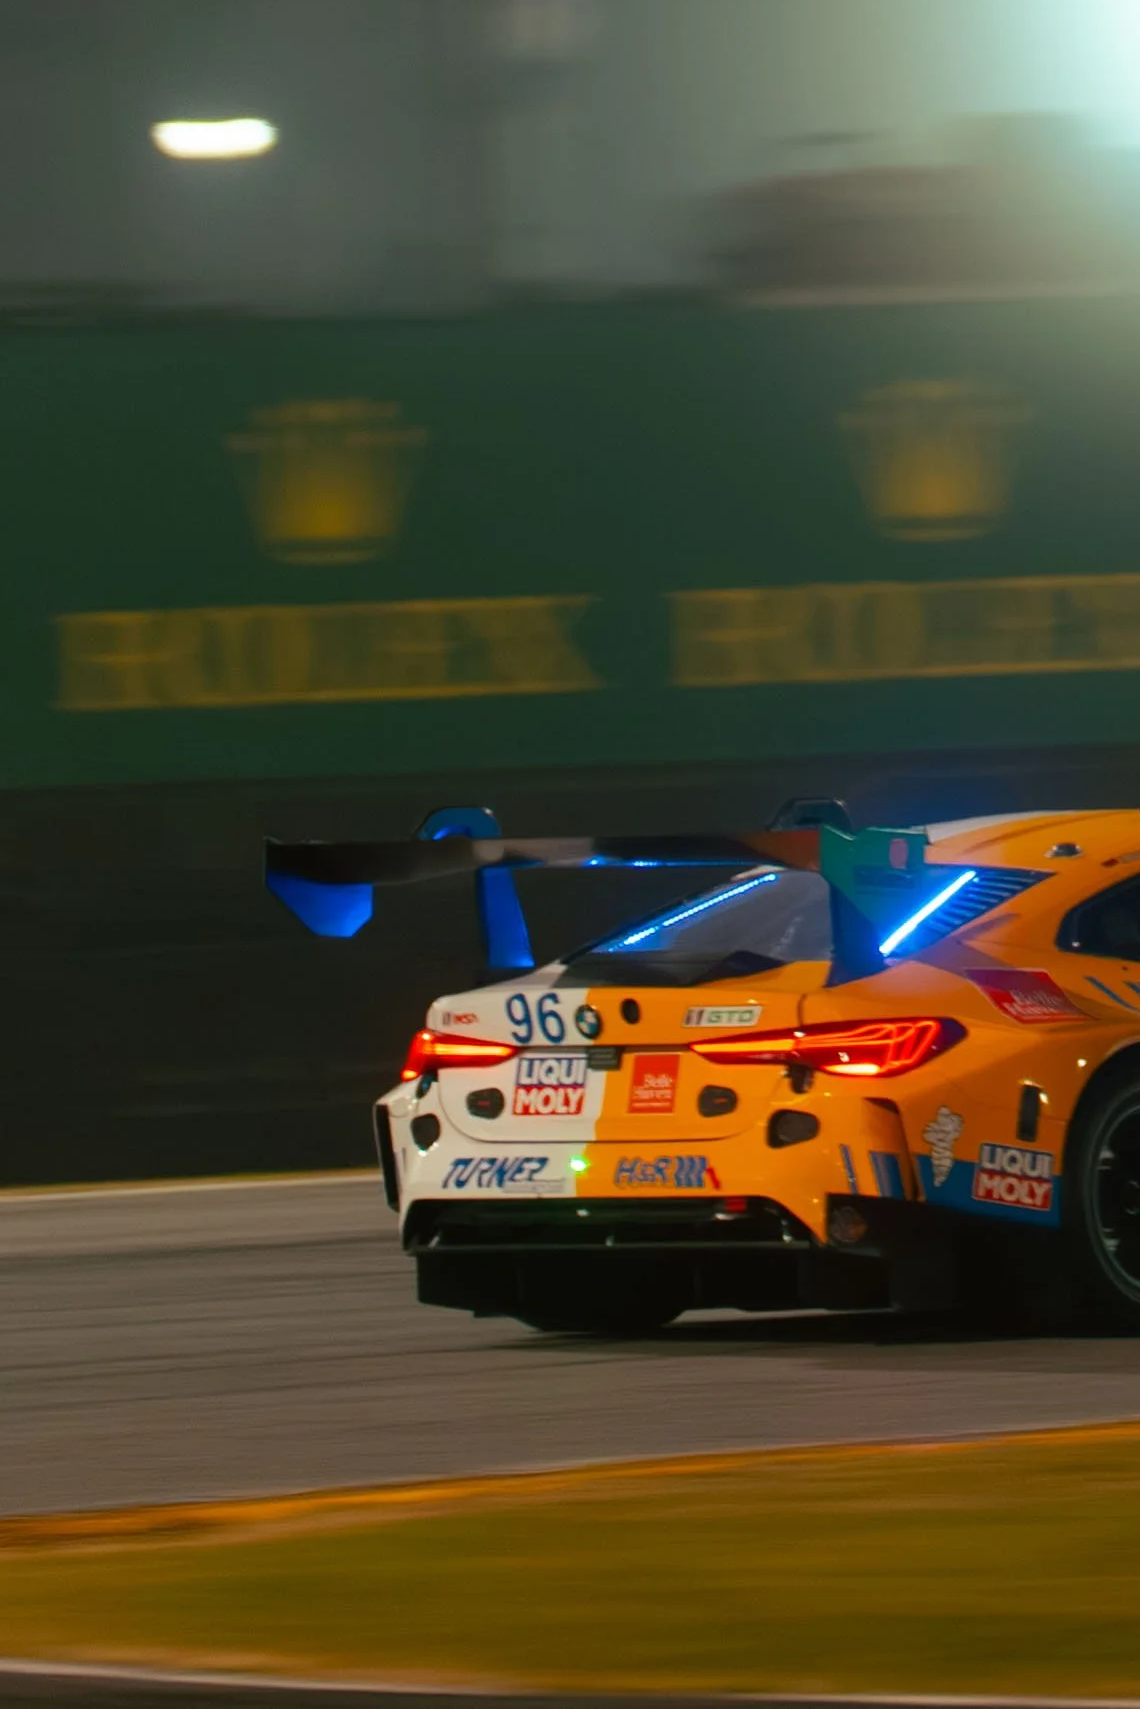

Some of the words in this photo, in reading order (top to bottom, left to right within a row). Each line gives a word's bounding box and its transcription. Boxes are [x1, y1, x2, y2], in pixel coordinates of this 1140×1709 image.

[506, 993, 566, 1044] 96
[519, 1058, 588, 1086] LIQUI
[514, 1087, 585, 1115] MOLY
[443, 1157, 549, 1189] TURNER
[981, 1144, 1052, 1180] LIQUI
[977, 1171, 1053, 1207] MOLY
